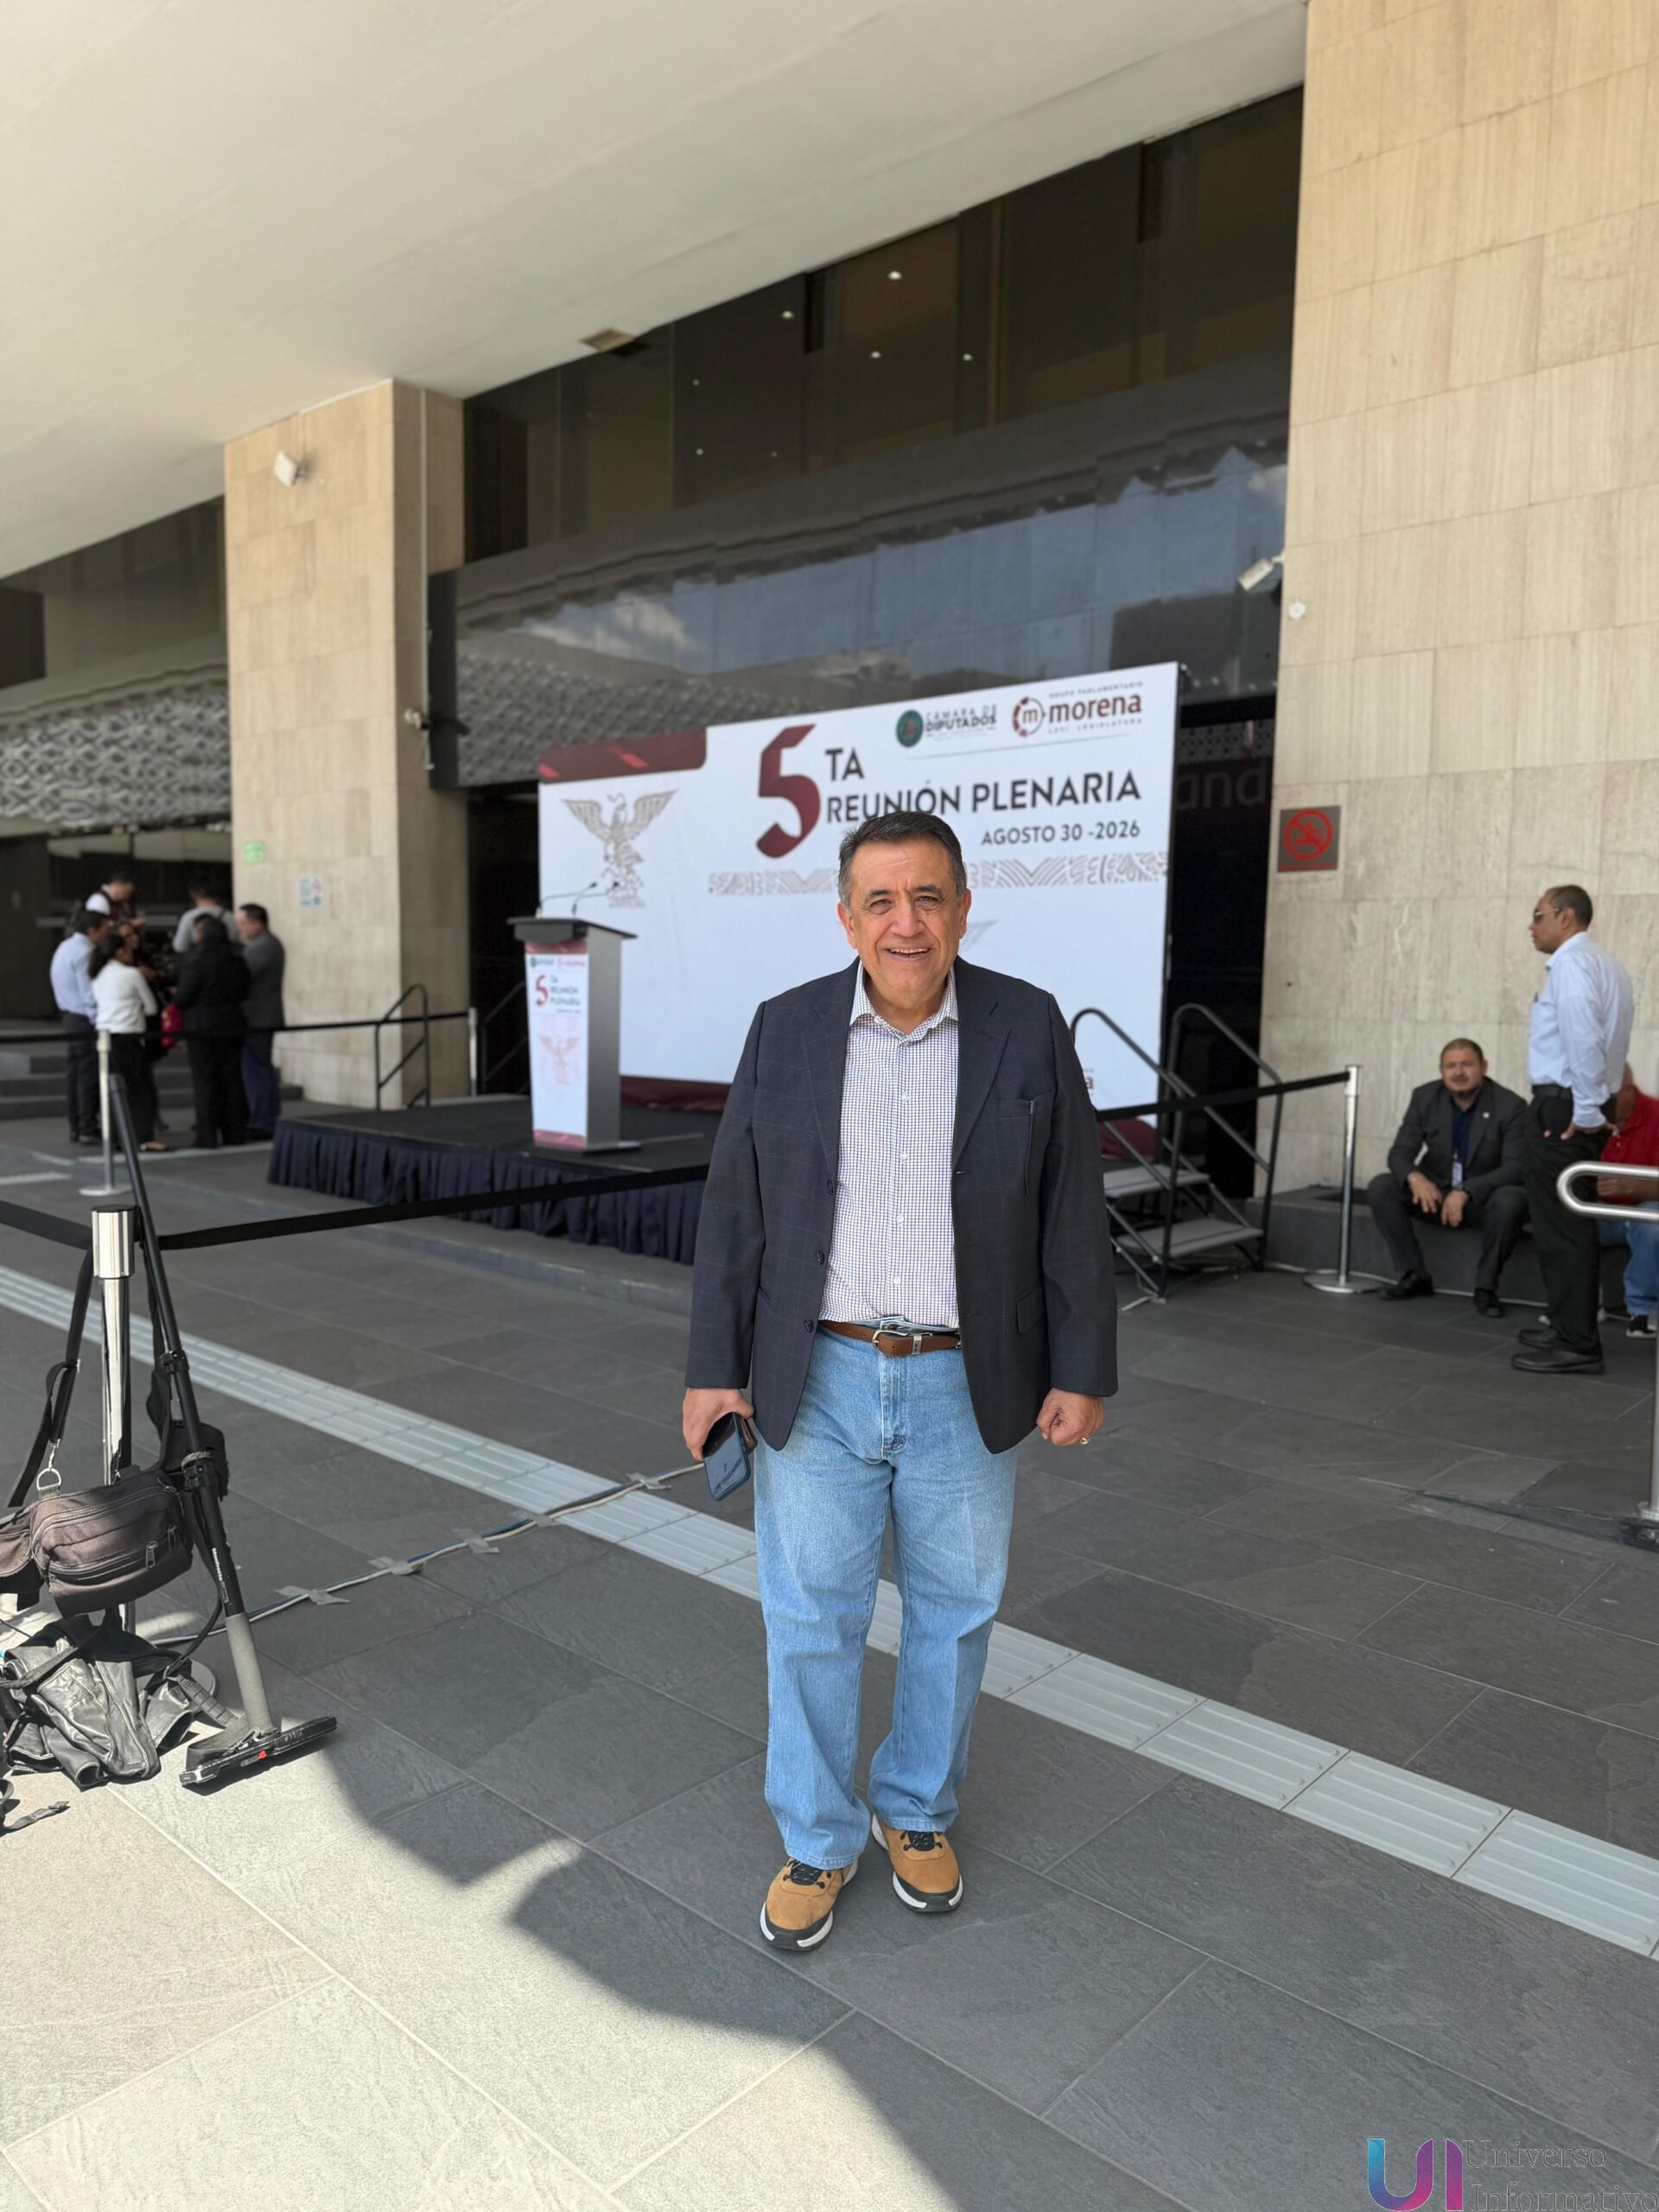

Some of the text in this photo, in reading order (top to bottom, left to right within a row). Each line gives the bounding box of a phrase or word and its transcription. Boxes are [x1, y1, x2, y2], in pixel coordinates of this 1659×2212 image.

[1049, 694, 1142, 723] morena
[925, 714, 996, 733] DIPUTADOS
[756, 723, 865, 858] 5 TA
[827, 770, 1141, 823] REUNIÓN PLENARIA
[981, 824, 1056, 846] AGOSTO
[1060, 823, 1083, 842] 30
